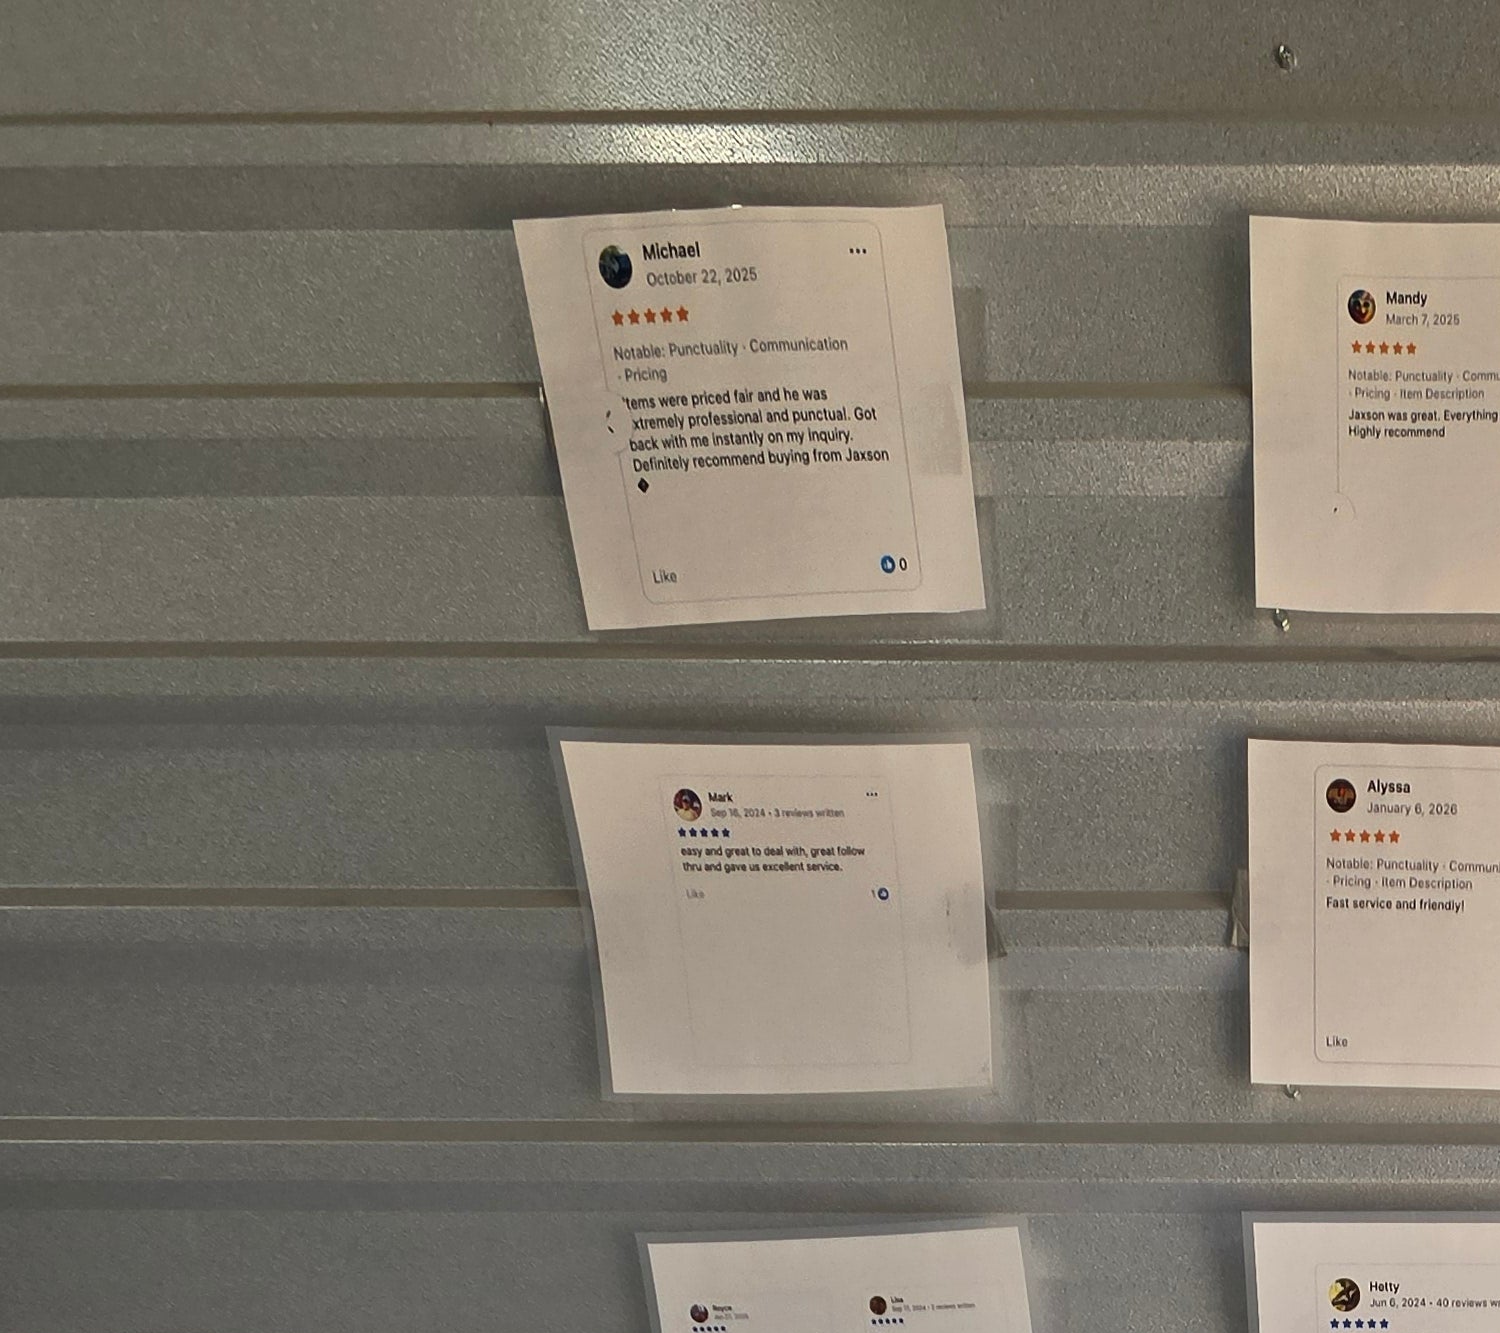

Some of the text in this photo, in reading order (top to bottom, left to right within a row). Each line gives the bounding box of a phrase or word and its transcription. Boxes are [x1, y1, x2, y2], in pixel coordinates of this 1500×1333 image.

[643, 242, 700, 260] Michael
[647, 267, 757, 287] October 22, 2025
[1387, 291, 1427, 307] Mandy
[1386, 314, 1418, 325] March
[1422, 314, 1429, 327] 7,
[614, 337, 848, 360] Notable: Punctuality Communication
[625, 367, 667, 383] Pricing
[622, 387, 827, 410] tems were priced fair and he was
[1349, 409, 1385, 421] Jaxson
[1388, 412, 1407, 421] was
[1411, 411, 1440, 423] great.
[1444, 409, 1498, 423] Everything
[1349, 426, 1445, 439] Highly recommend
[633, 448, 889, 472] Definitely recommend buying from Jaxson
[899, 558, 907, 571] 0
[653, 570, 677, 584] Like
[1368, 779, 1410, 795] Alyssa
[708, 792, 733, 802] Mark
[1367, 802, 1457, 816] January 6, 2026
[681, 848, 702, 858] easy
[705, 846, 722, 856] and
[725, 847, 750, 858] great
[750, 847, 761, 856] to
[764, 846, 783, 856] deal
[811, 847, 835, 858] great
[837, 846, 865, 856] follow
[1327, 858, 1372, 869] Notable:
[1377, 859, 1439, 873] Punctuality
[1333, 875, 1472, 891] Pricing Item Description
[1327, 897, 1464, 913] Fast service and friendly!
[1326, 1036, 1347, 1047] Like
[1370, 1282, 1399, 1294] Hetty
[1370, 1299, 1386, 1307] Jun
[1402, 1298, 1425, 1307] 2024
[1437, 1298, 1449, 1307] 40
[1452, 1298, 1487, 1307] reviews
